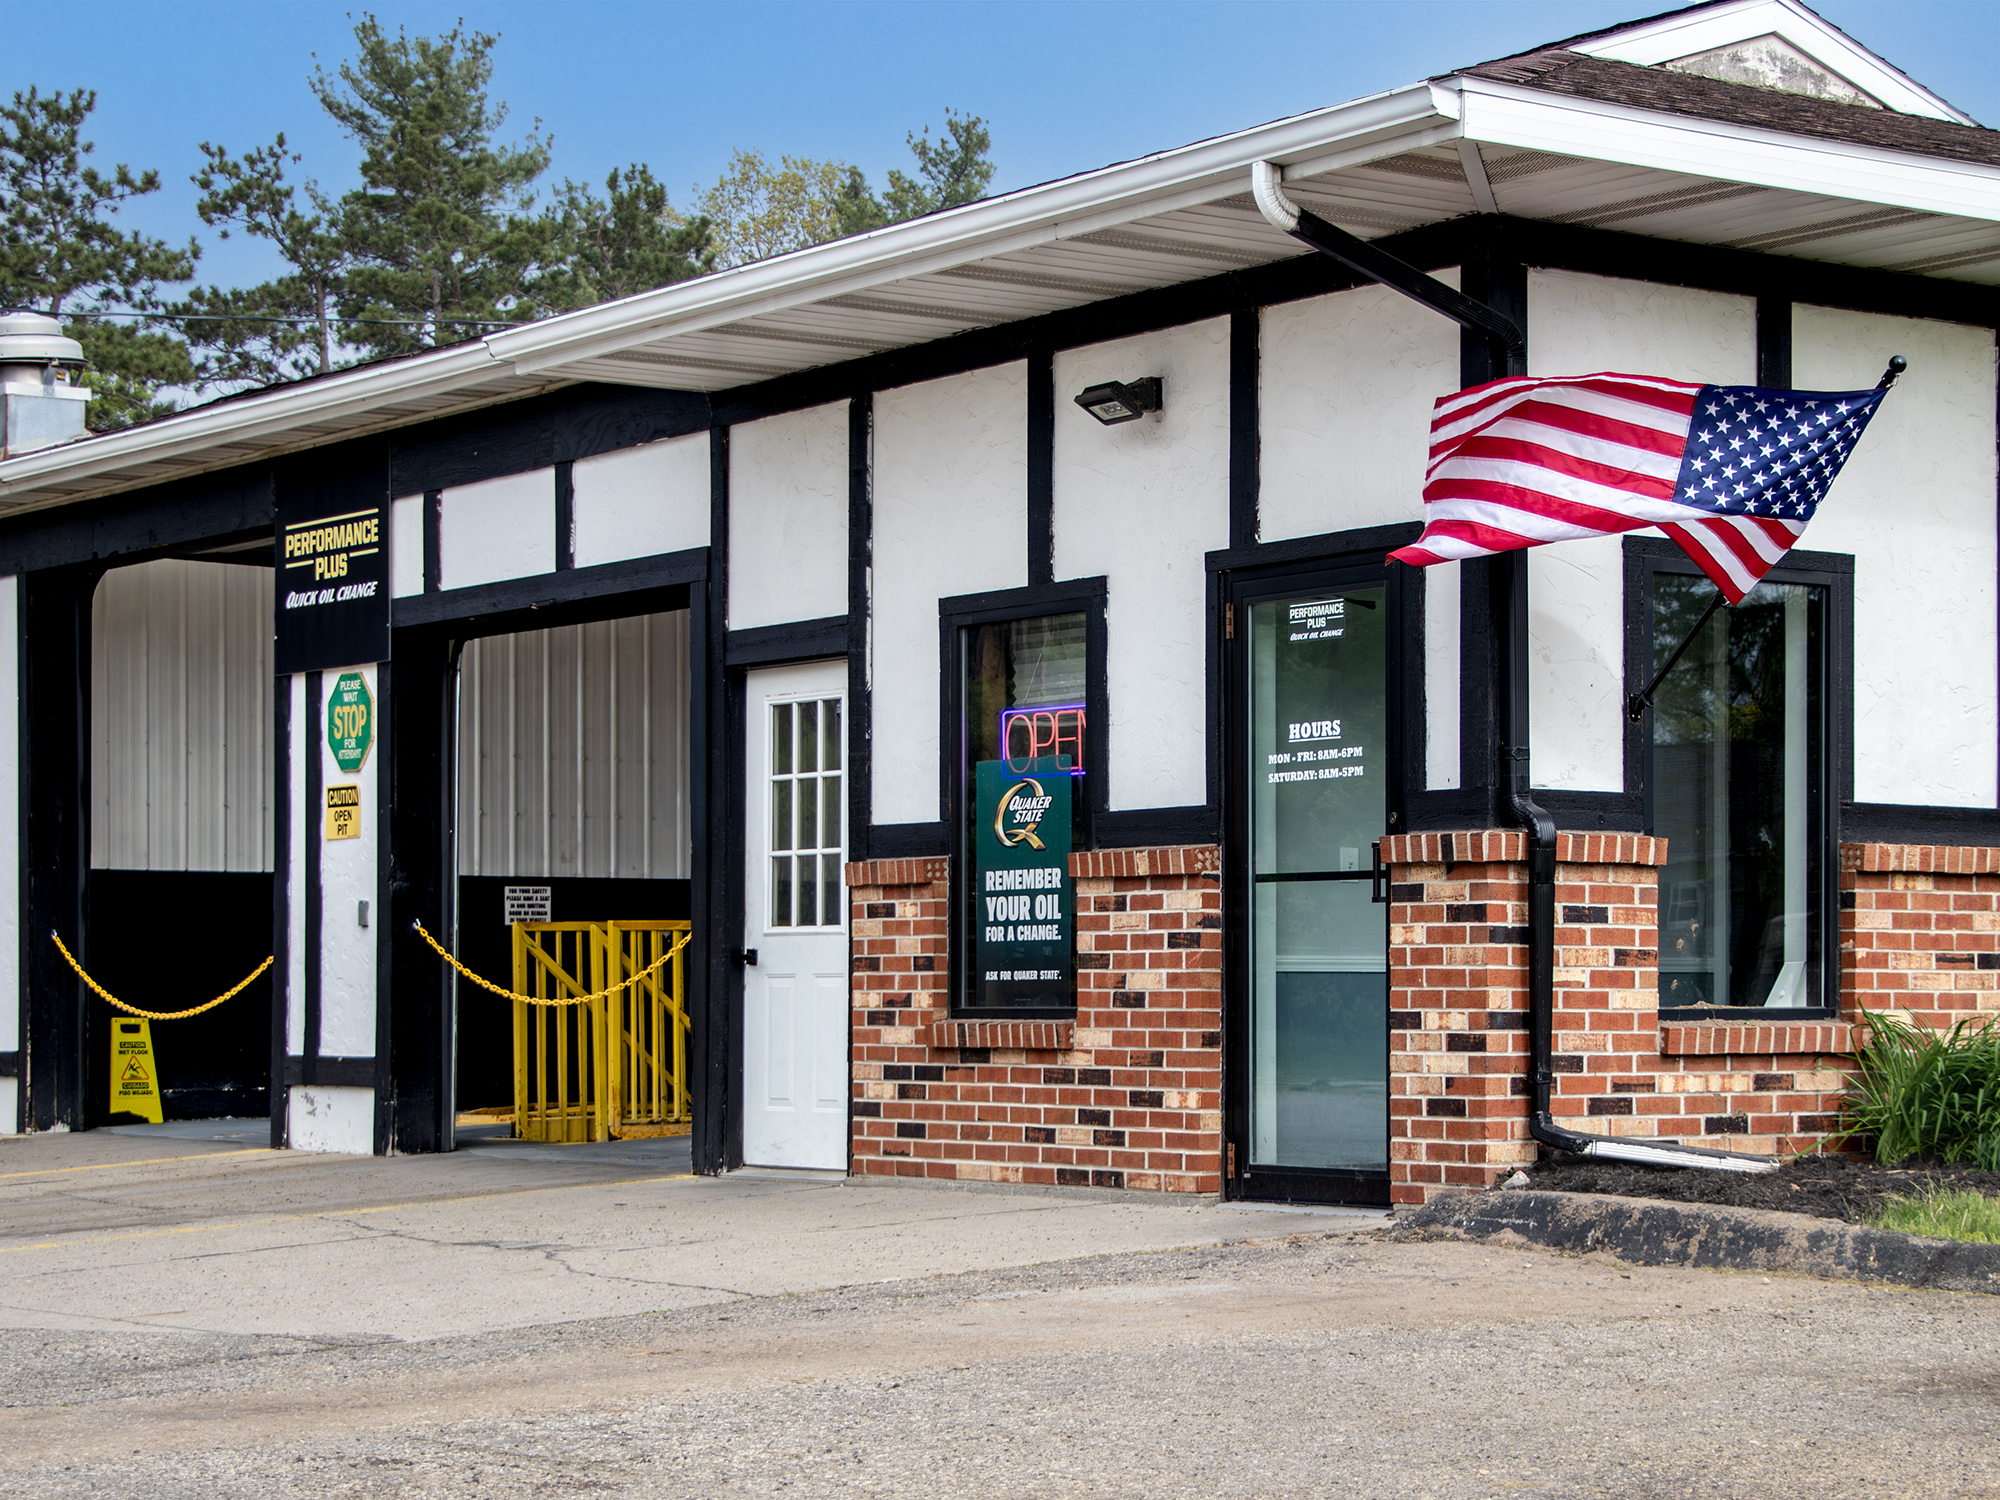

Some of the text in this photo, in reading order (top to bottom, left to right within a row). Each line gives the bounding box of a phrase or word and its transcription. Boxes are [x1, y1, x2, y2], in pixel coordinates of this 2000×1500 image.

[285, 518, 379, 558] PERFORMANCE
[315, 553, 348, 581] PLUS
[286, 581, 378, 609] QUICK OIL CHANGE
[1289, 602, 1344, 620] PERFORMANCE
[1307, 617, 1326, 630] PLUS
[1290, 628, 1344, 642] QUICK OIL CHANGE
[340, 680, 361, 691] PLEASE
[343, 691, 358, 702] WAIT
[333, 705, 367, 740] STOP
[1288, 719, 1341, 740] HOURS
[344, 739, 356, 748] FOR
[1268, 753, 1291, 765] MON
[1297, 751, 1317, 763] FRI:
[1317, 746, 1363, 761] 8AM-6PM
[1268, 765, 1364, 783] SATURDAY: 8AM-5PM
[328, 788, 358, 806] CAUTION
[1009, 795, 1053, 811] QUAKER
[334, 810, 353, 822] OPEN
[1013, 809, 1045, 824] STATE
[337, 823, 348, 836] PIT
[985, 867, 1062, 891] REMEMBER
[985, 894, 1062, 922] YOUR OIL
[985, 924, 1062, 942] FOR A CHANGE.
[985, 971, 998, 981] ASK
[1000, 971, 1012, 981] FOR
[1013, 970, 1038, 981] QUAKER
